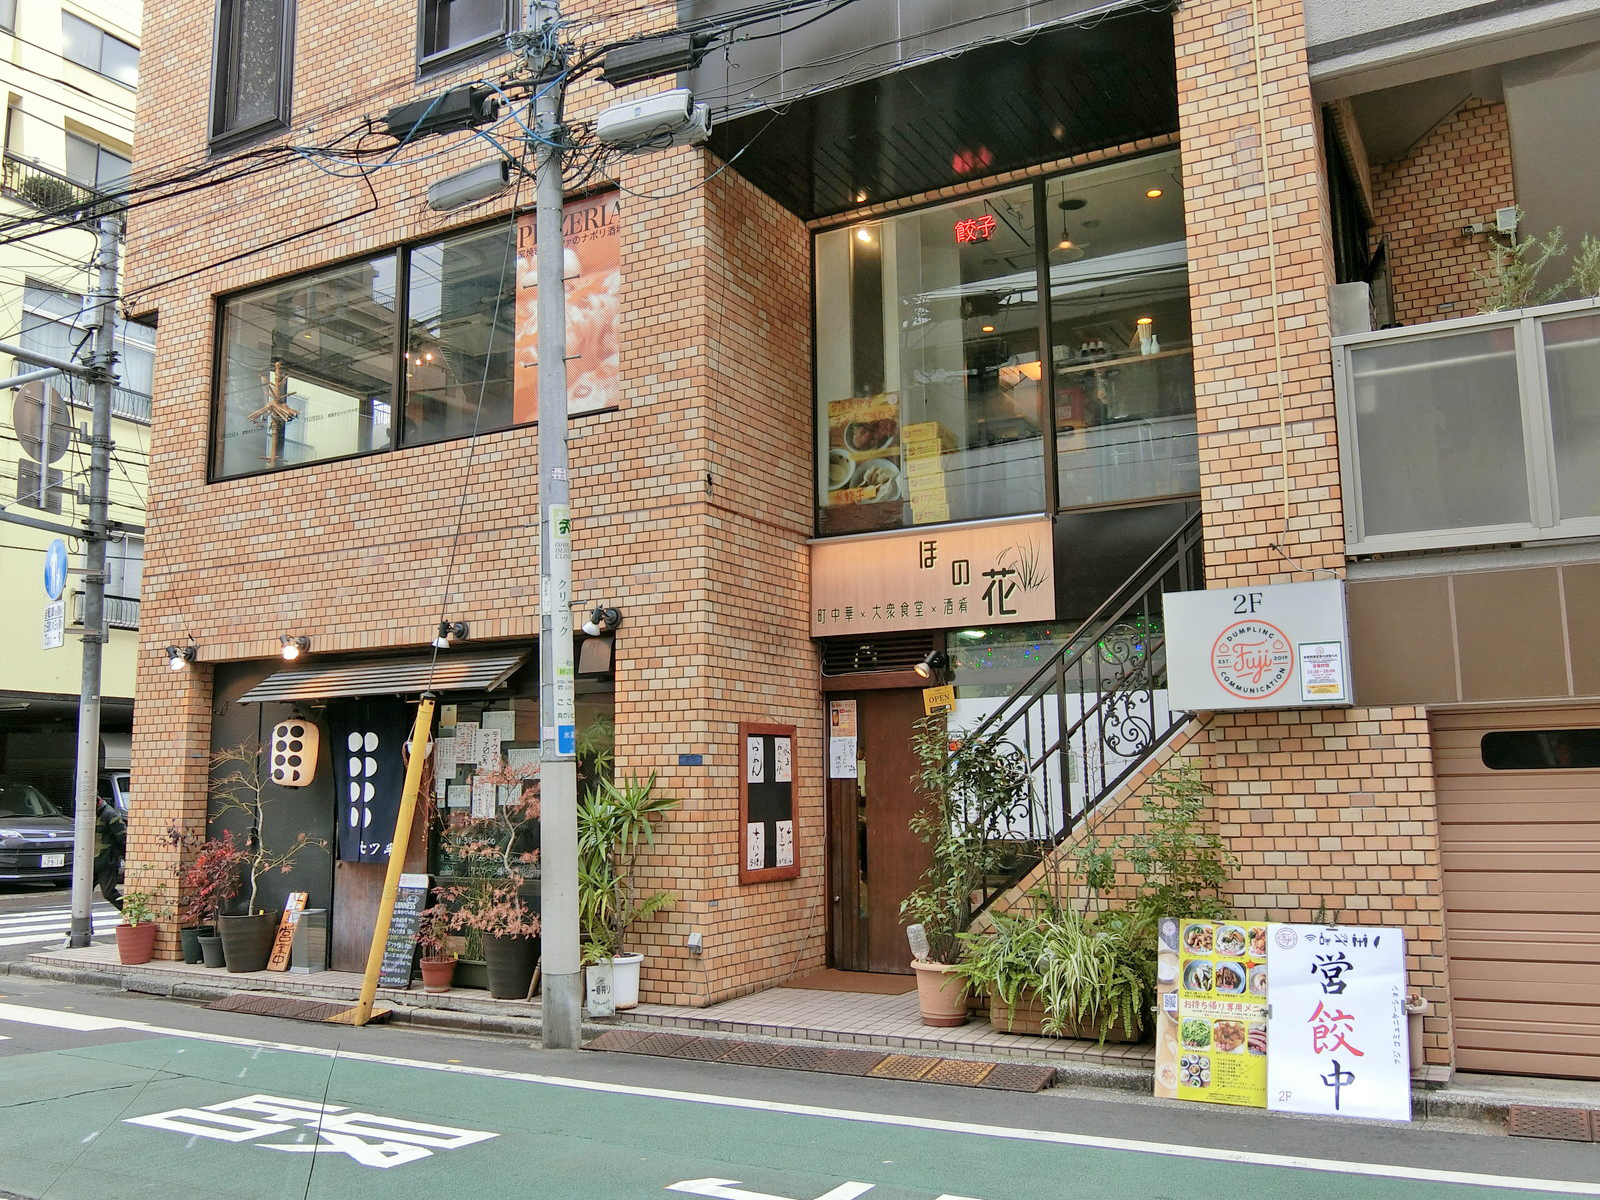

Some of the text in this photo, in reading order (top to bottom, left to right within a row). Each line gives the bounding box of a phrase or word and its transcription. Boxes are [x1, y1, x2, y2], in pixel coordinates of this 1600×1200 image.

[955, 215, 996, 243] 餃子
[918, 540, 1018, 618] ほの花
[557, 579, 569, 637] クリニック
[1233, 592, 1263, 615] 2F
[1226, 626, 1275, 642] DUMPLING
[1232, 639, 1274, 684] Fuji
[1219, 666, 1287, 694] COMMUNICATION
[929, 694, 950, 703] OPEN
[1307, 951, 1365, 1111] 営餃中
[1278, 1091, 1293, 1103] 2F
